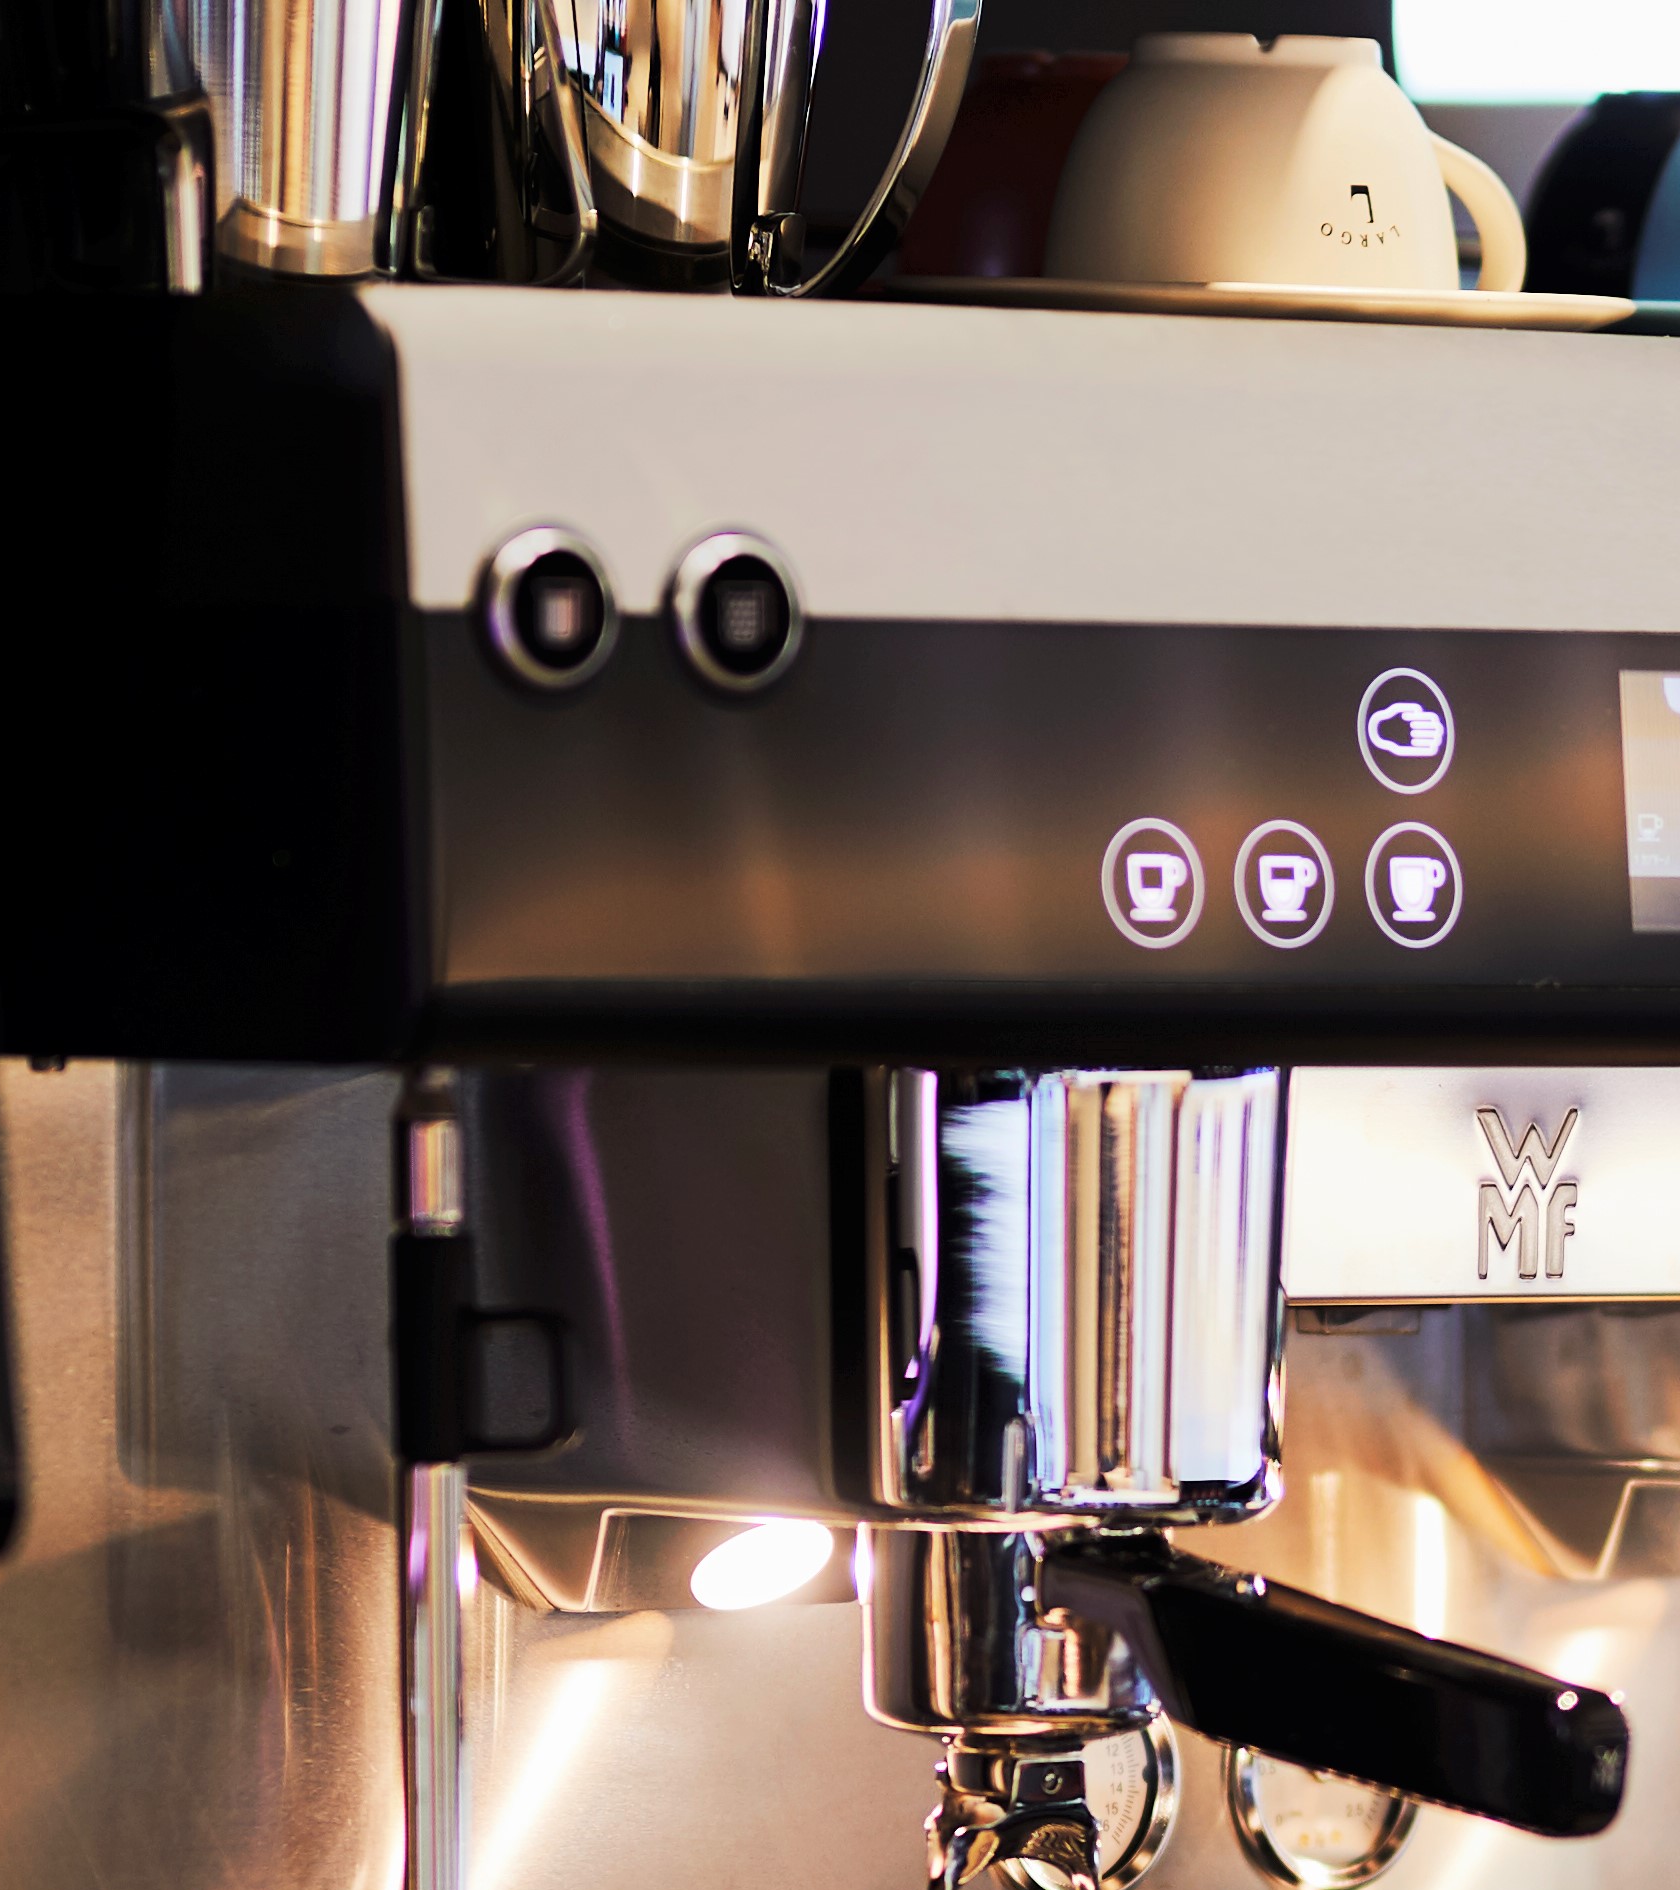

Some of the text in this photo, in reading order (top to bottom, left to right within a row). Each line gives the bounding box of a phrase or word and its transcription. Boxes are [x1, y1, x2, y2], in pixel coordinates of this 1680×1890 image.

[1320, 222, 1400, 248] LARGO
[1105, 1743, 1119, 1757] 12
[1110, 1762, 1124, 1775] 13
[1110, 1782, 1123, 1795] 14
[1105, 1801, 1119, 1816] 15
